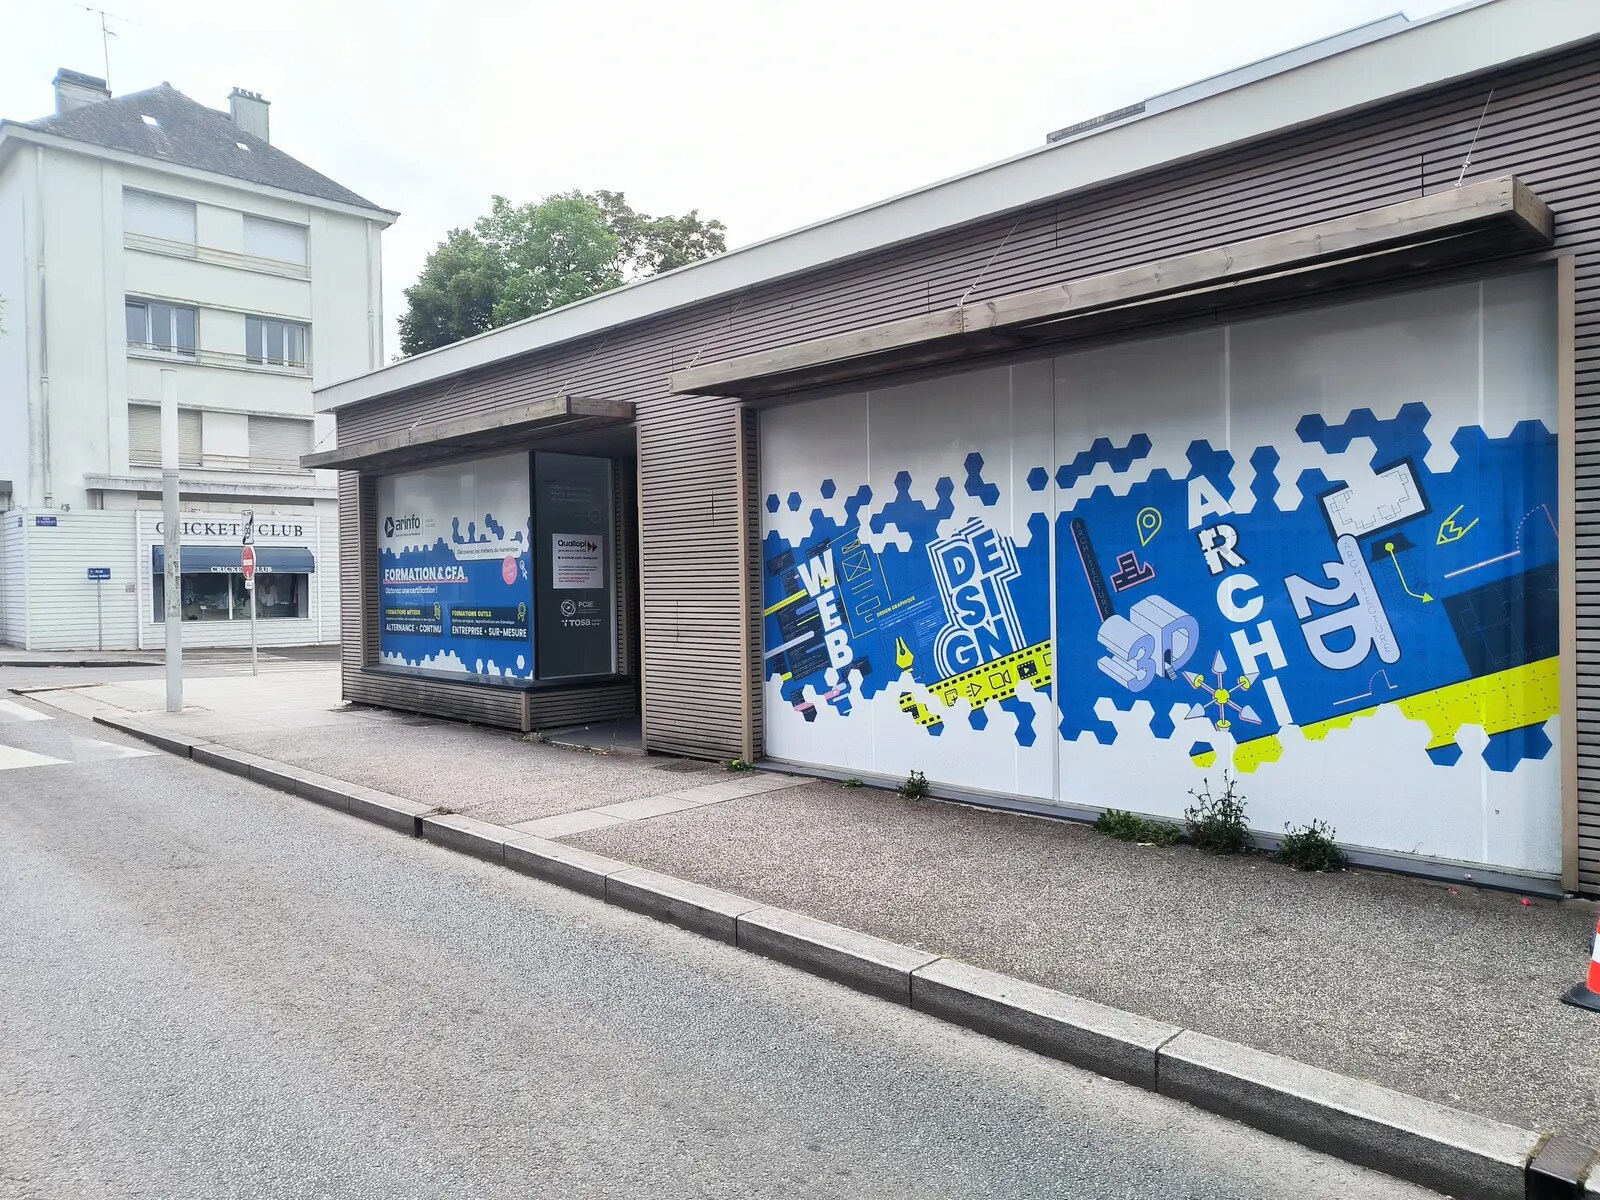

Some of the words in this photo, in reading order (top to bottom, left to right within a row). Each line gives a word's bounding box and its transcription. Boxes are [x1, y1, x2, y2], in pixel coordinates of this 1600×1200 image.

[156, 522, 240, 536] CICKET
[258, 524, 303, 537] CLUB
[395, 514, 420, 531] arinfo
[384, 567, 436, 581] FORMATION
[445, 566, 465, 580] CFA
[1188, 474, 1294, 726] ARCHI
[797, 549, 853, 670] WEB
[1284, 561, 1373, 670] 2D
[386, 623, 415, 632] ALTERNANCE
[419, 624, 441, 633] CONTINU
[452, 626, 483, 635] ENTREPRISE
[488, 627, 527, 638] SUR-MESURE
[1097, 594, 1199, 693] 3D
